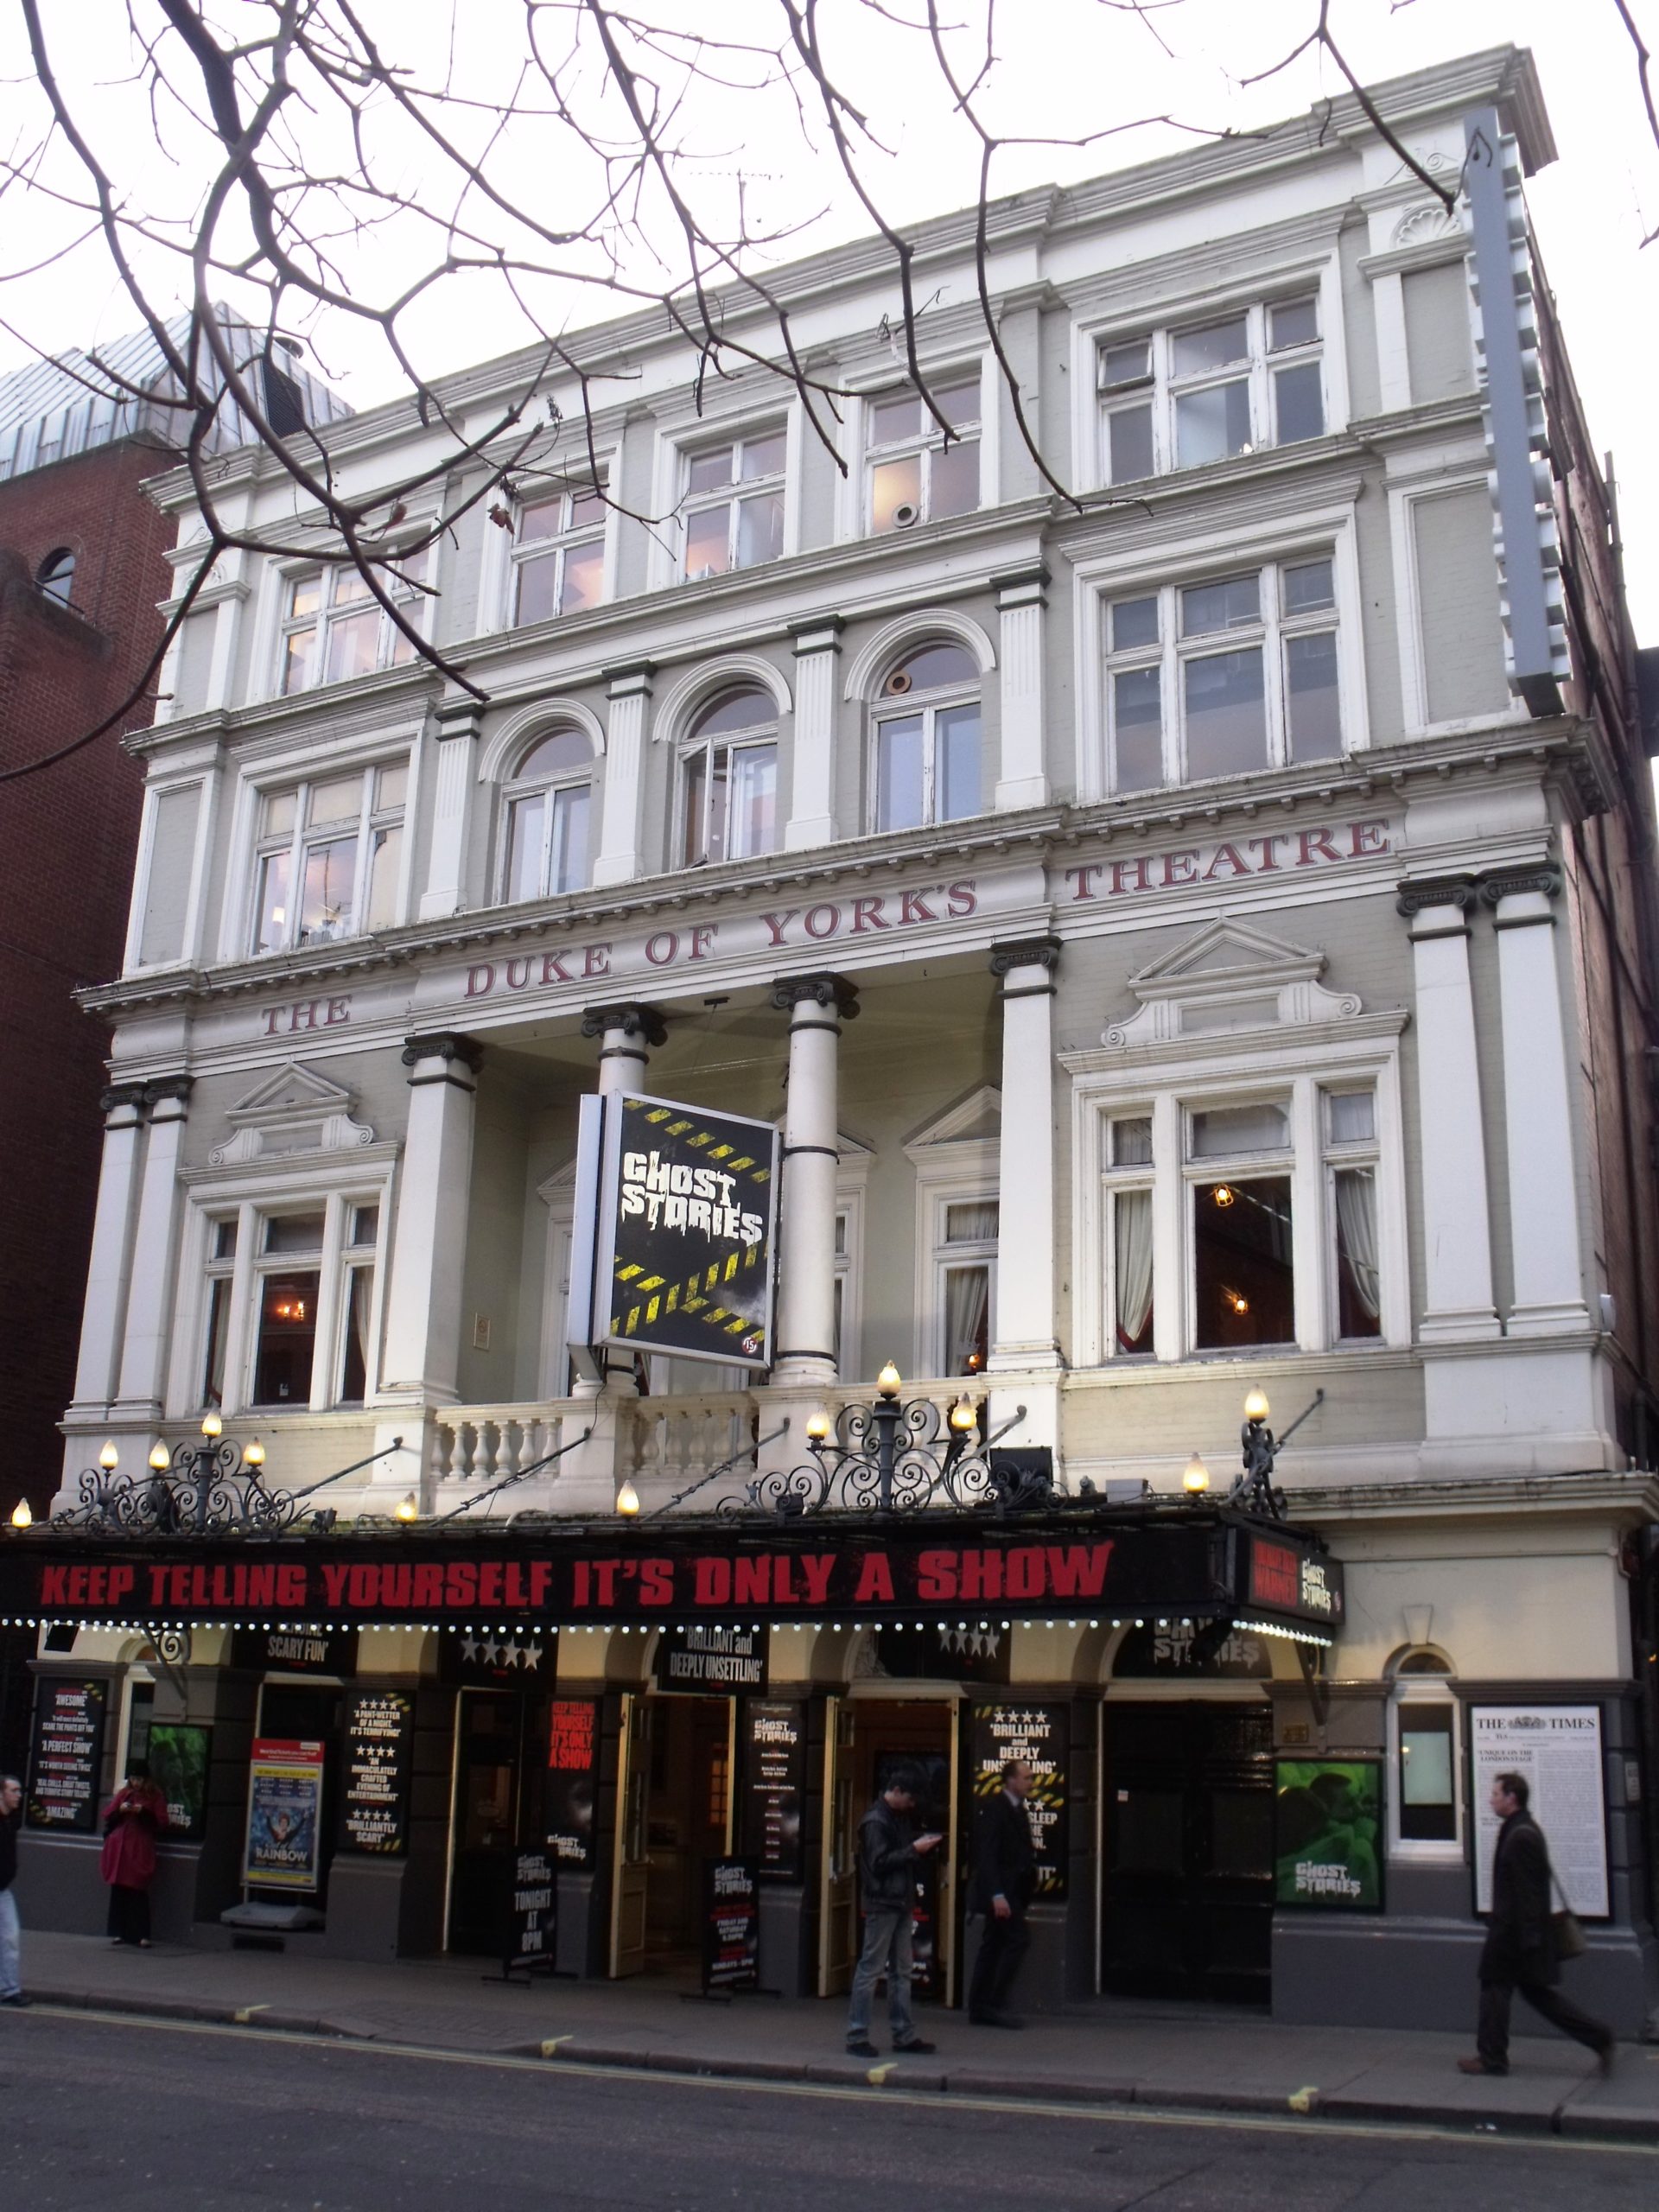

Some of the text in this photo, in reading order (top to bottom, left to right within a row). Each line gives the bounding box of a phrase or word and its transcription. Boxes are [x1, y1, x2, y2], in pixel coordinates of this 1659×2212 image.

[263, 817, 1389, 1036] THE DUKE OF YORK'S THEATRE
[624, 1150, 736, 1208] GHOST
[622, 1183, 763, 1247] STORIES
[41, 1541, 1115, 1607] KEEP TELLING YOURSELF IT'S ONLY A SHOW
[268, 1636, 304, 1659] SCARY
[734, 1632, 753, 1656] and
[671, 1652, 704, 1678] DEEPLY
[552, 1714, 594, 1731] YOURSELF
[1477, 1718, 1595, 1729] THE TIMES
[1000, 1745, 1039, 1759] DEEPLY
[1012, 1738, 1028, 1746] and
[549, 1747, 593, 1770] A SHOW
[256, 1847, 308, 1862] RAINBOW
[1296, 1860, 1347, 1879] GHOST
[1296, 1876, 1361, 1897] STORIES
[514, 1889, 551, 1911] TONIGHT
[527, 1910, 538, 1930] AT
